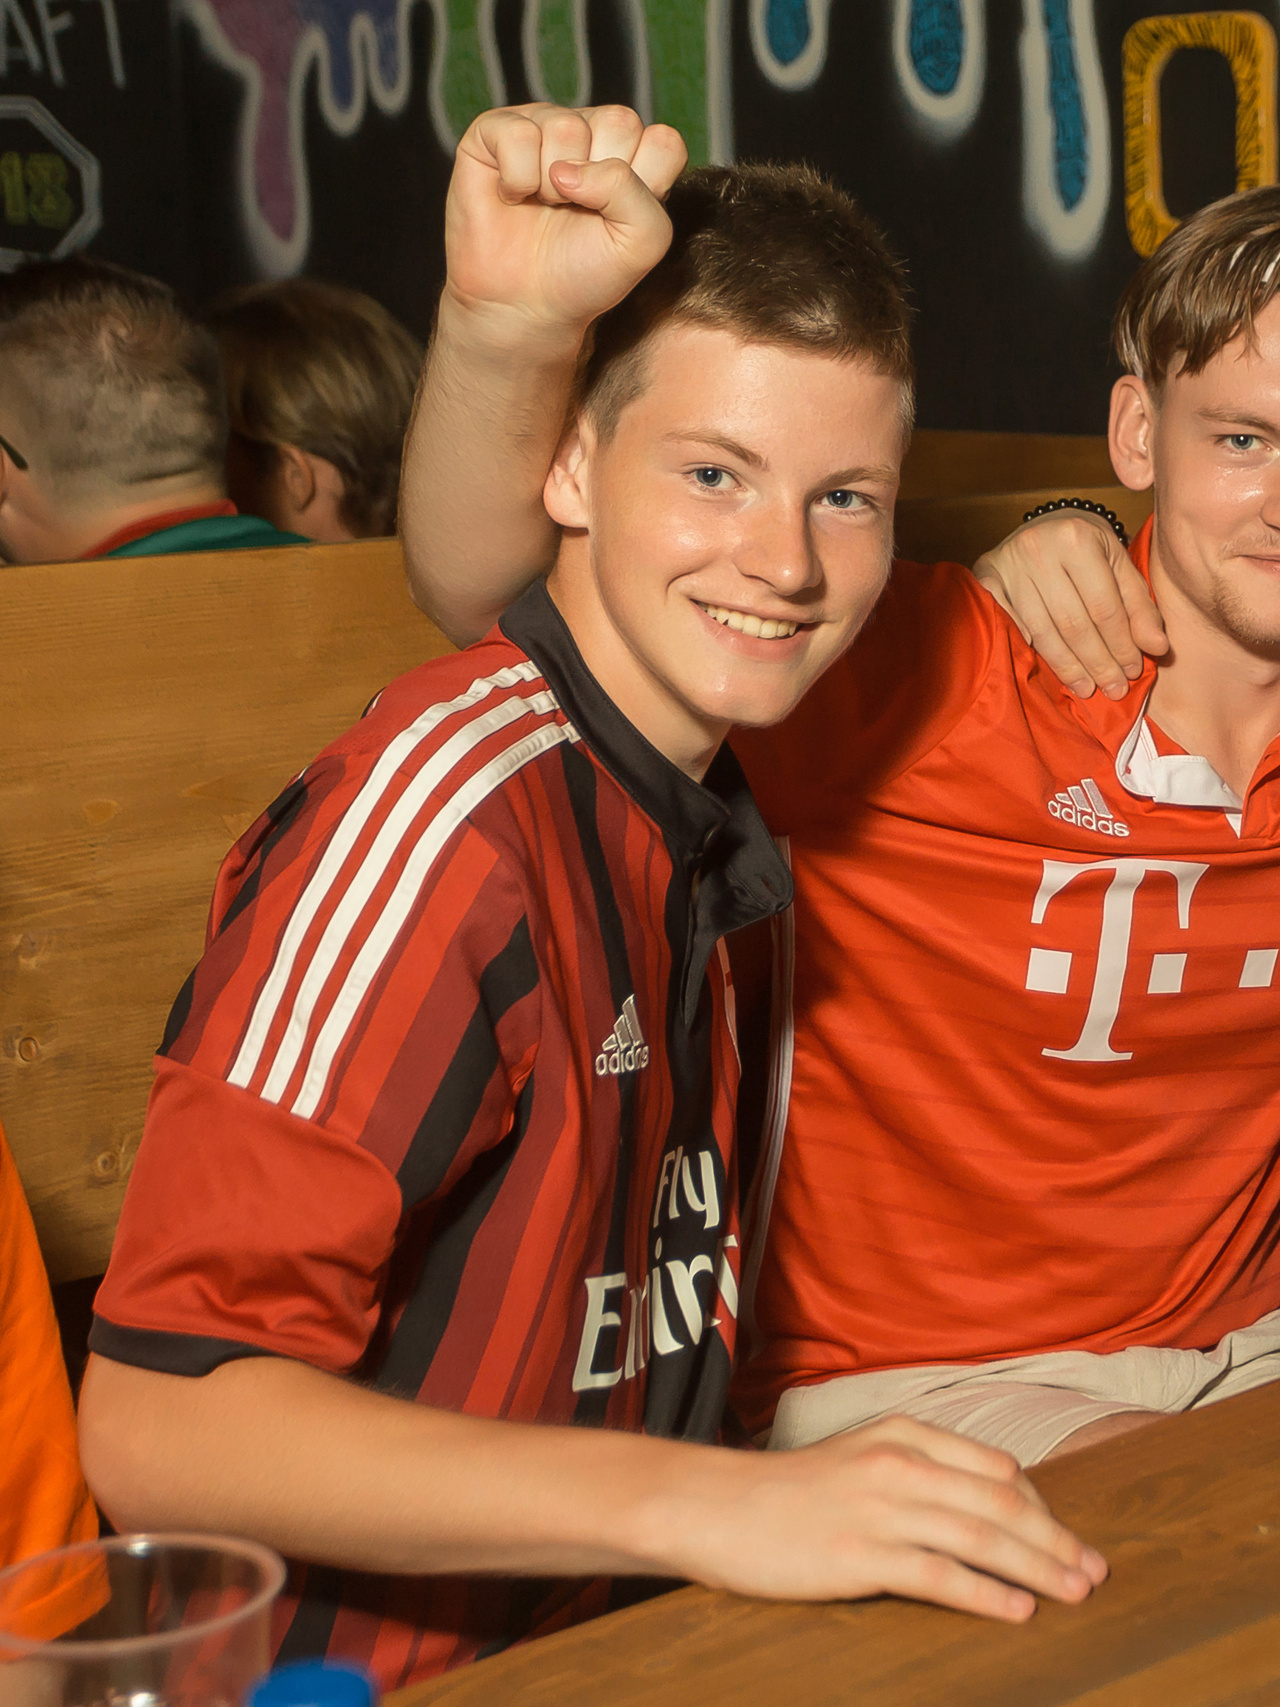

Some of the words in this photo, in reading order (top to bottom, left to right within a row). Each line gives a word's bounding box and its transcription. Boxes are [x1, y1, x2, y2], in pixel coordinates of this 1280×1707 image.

[1047, 798, 1130, 838] adidas
[1031, 858, 1210, 1061] T
[595, 1045, 649, 1076] adidas
[652, 1145, 720, 1230] Fly
